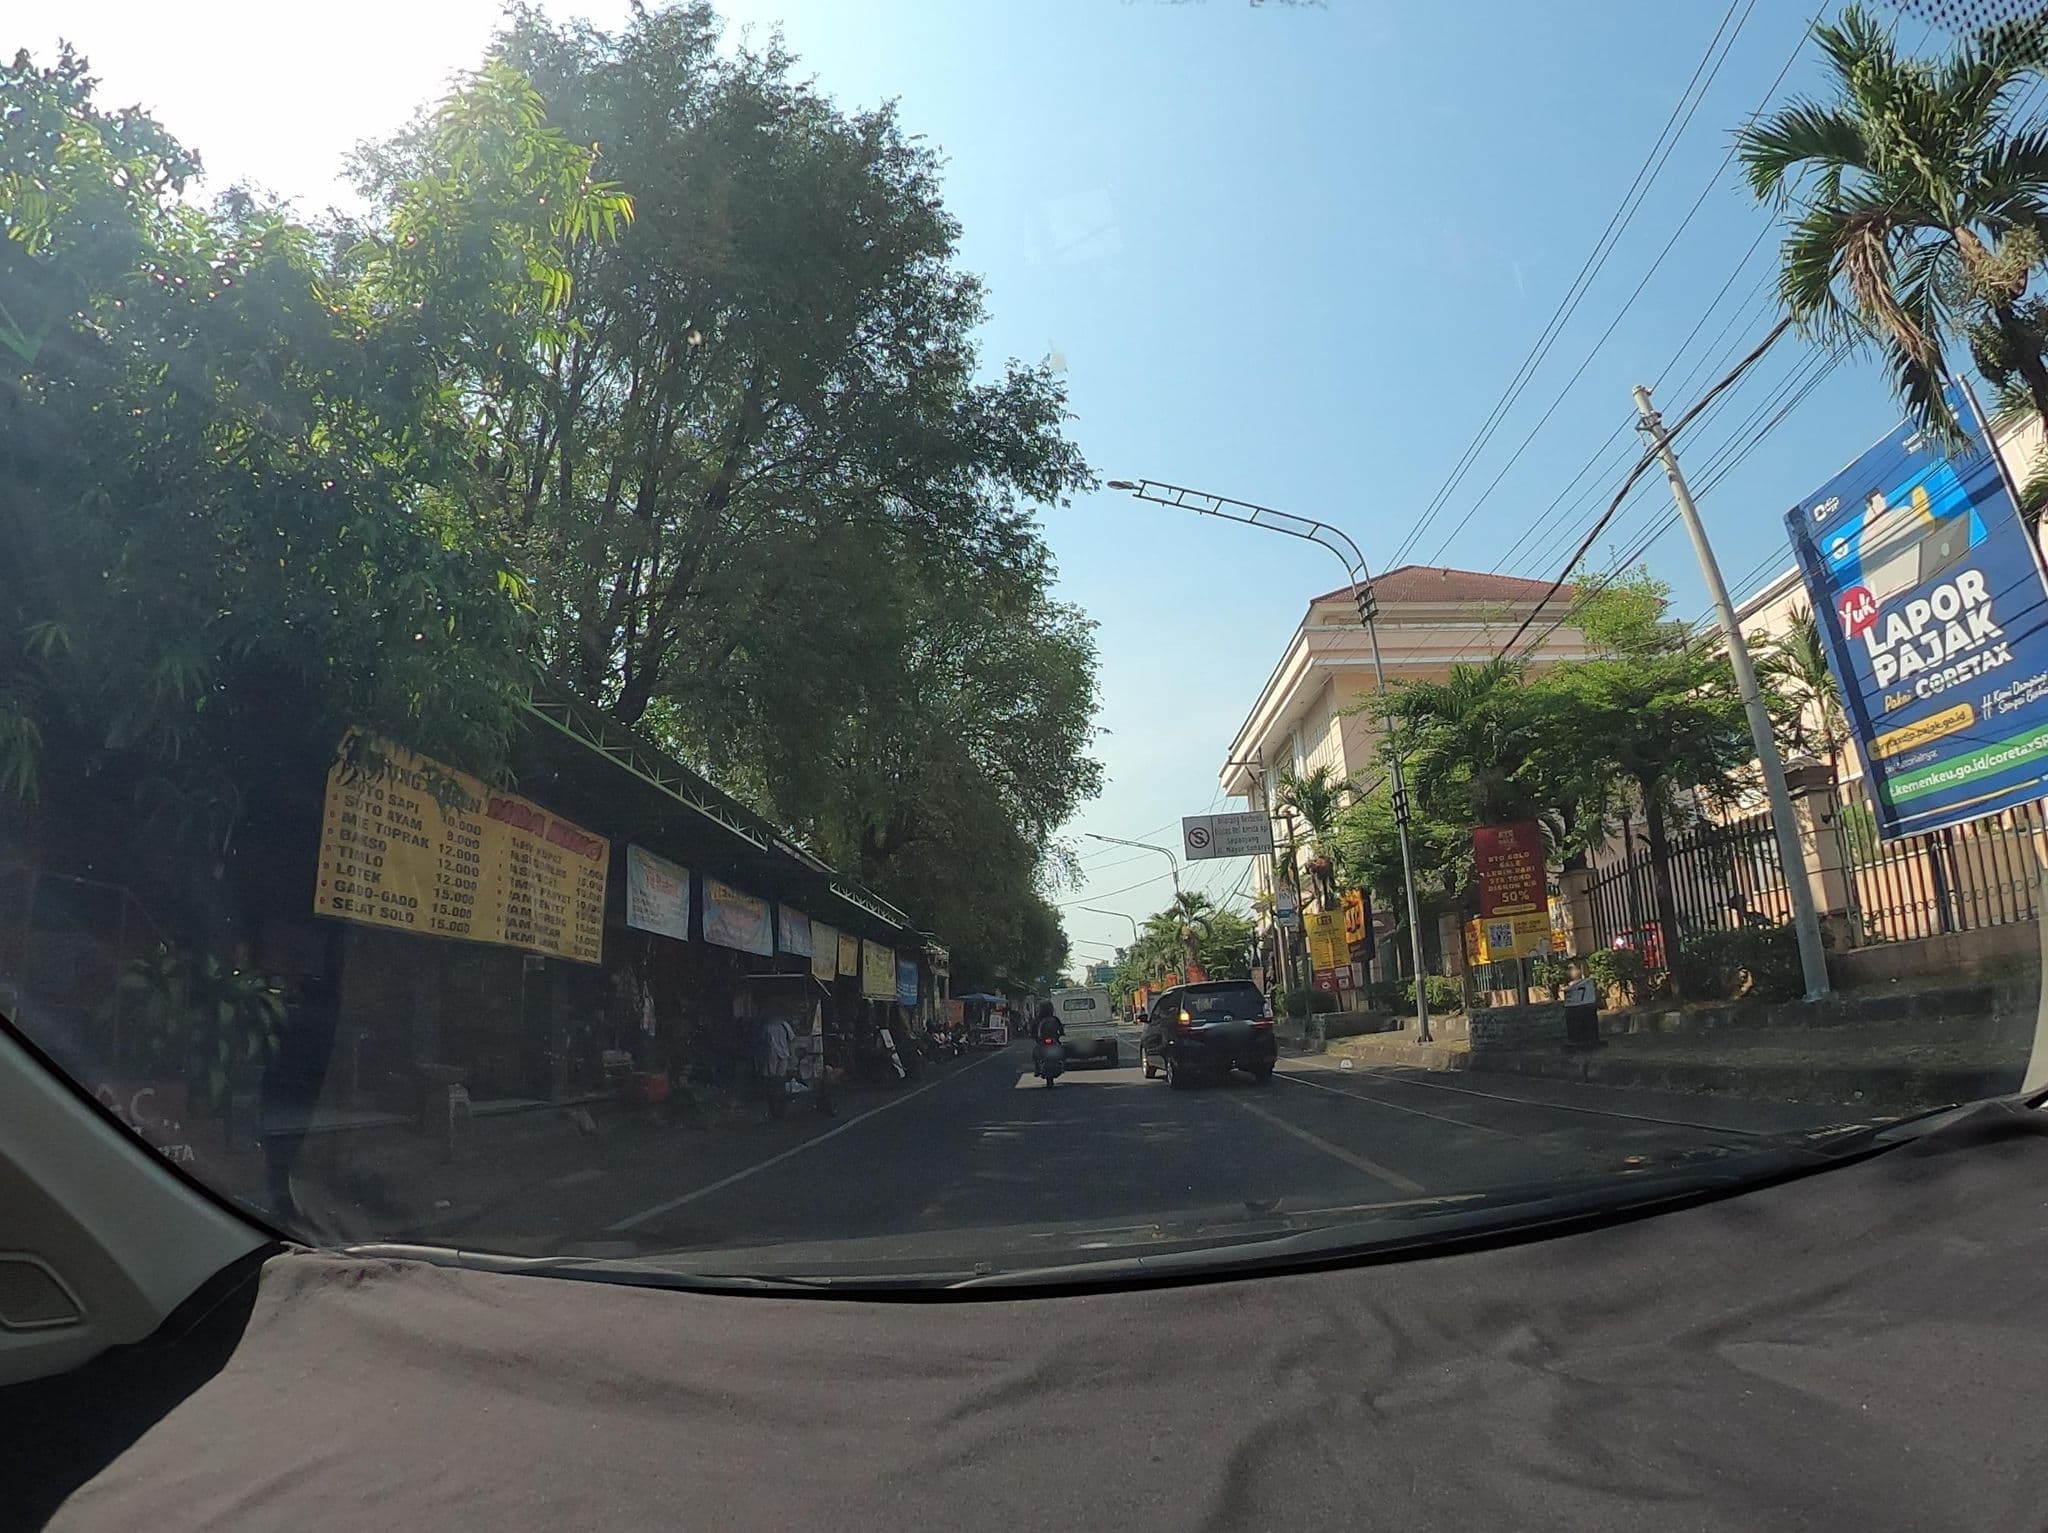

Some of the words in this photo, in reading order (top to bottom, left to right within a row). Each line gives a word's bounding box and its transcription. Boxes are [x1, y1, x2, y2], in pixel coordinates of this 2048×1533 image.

[1841, 594, 1877, 640] Yuk
[1863, 569, 1991, 658] LAPOR
[1873, 600, 2003, 689] PAJAK
[1915, 641, 2013, 700] CORETAX
[387, 810, 423, 831] AYAM
[388, 794, 420, 814] SAPI
[376, 822, 430, 849] TOPRAK
[439, 843, 480, 864] 12.000
[336, 862, 382, 884] LOTEK
[433, 888, 474, 905] 15.000
[436, 873, 477, 892] 12.000
[438, 858, 480, 877] 12.000
[334, 880, 418, 909] GADO-GADO
[431, 903, 472, 919] 15.000
[1501, 889, 1530, 904] 50%
[380, 907, 415, 924] SOLO
[430, 918, 470, 935] 15.000
